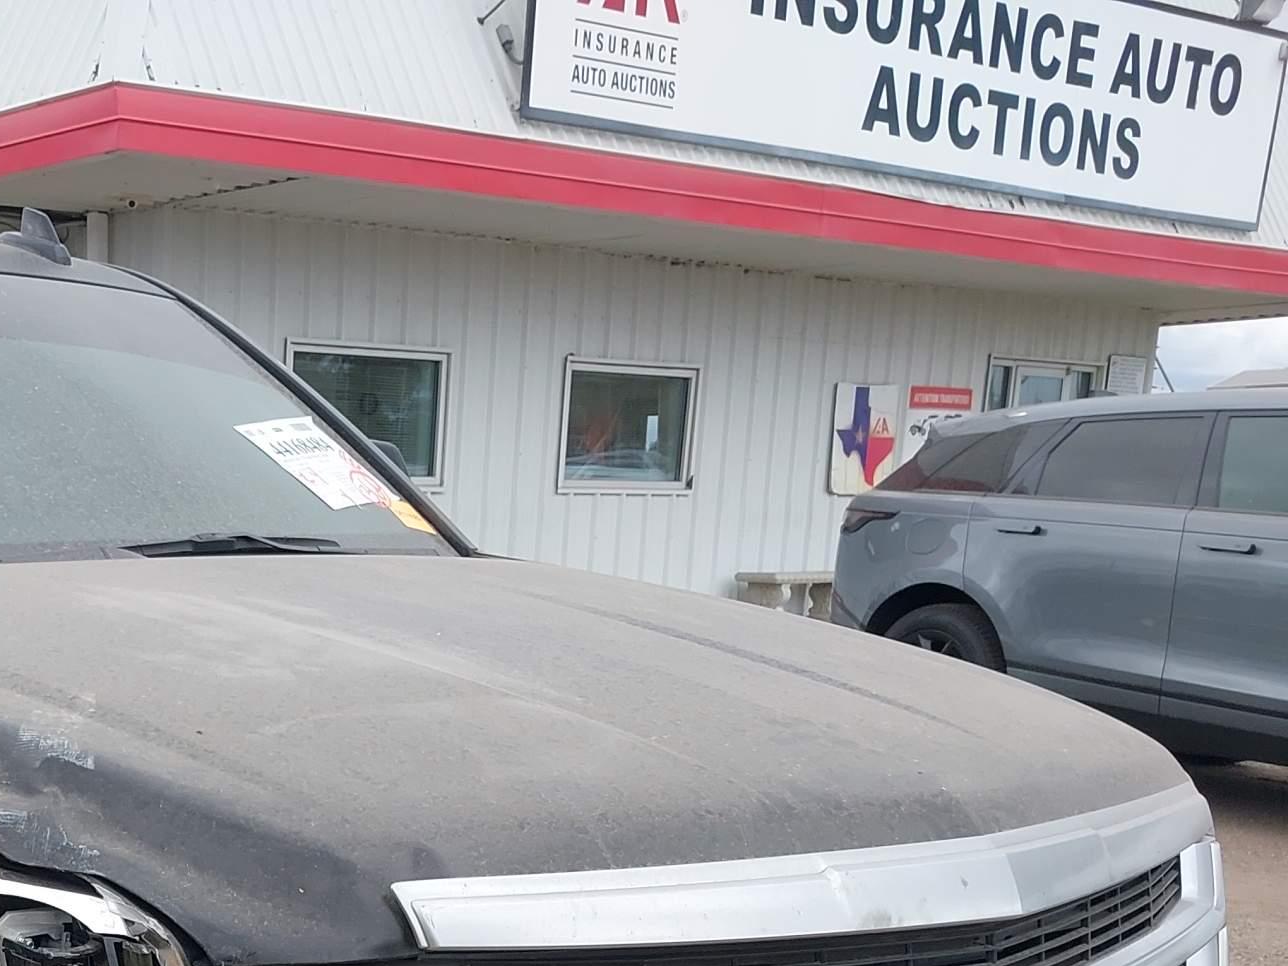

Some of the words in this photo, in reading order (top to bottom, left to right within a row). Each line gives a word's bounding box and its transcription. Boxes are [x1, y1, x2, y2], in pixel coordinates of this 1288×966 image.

[571, 64, 607, 88] AUTO
[611, 71, 676, 99] AUCTIONS
[575, 28, 678, 65] INSURANCE
[750, 0, 1100, 88] SURANCE
[1110, 33, 1243, 116] AUTO
[861, 65, 1142, 180] AUCTIONS
